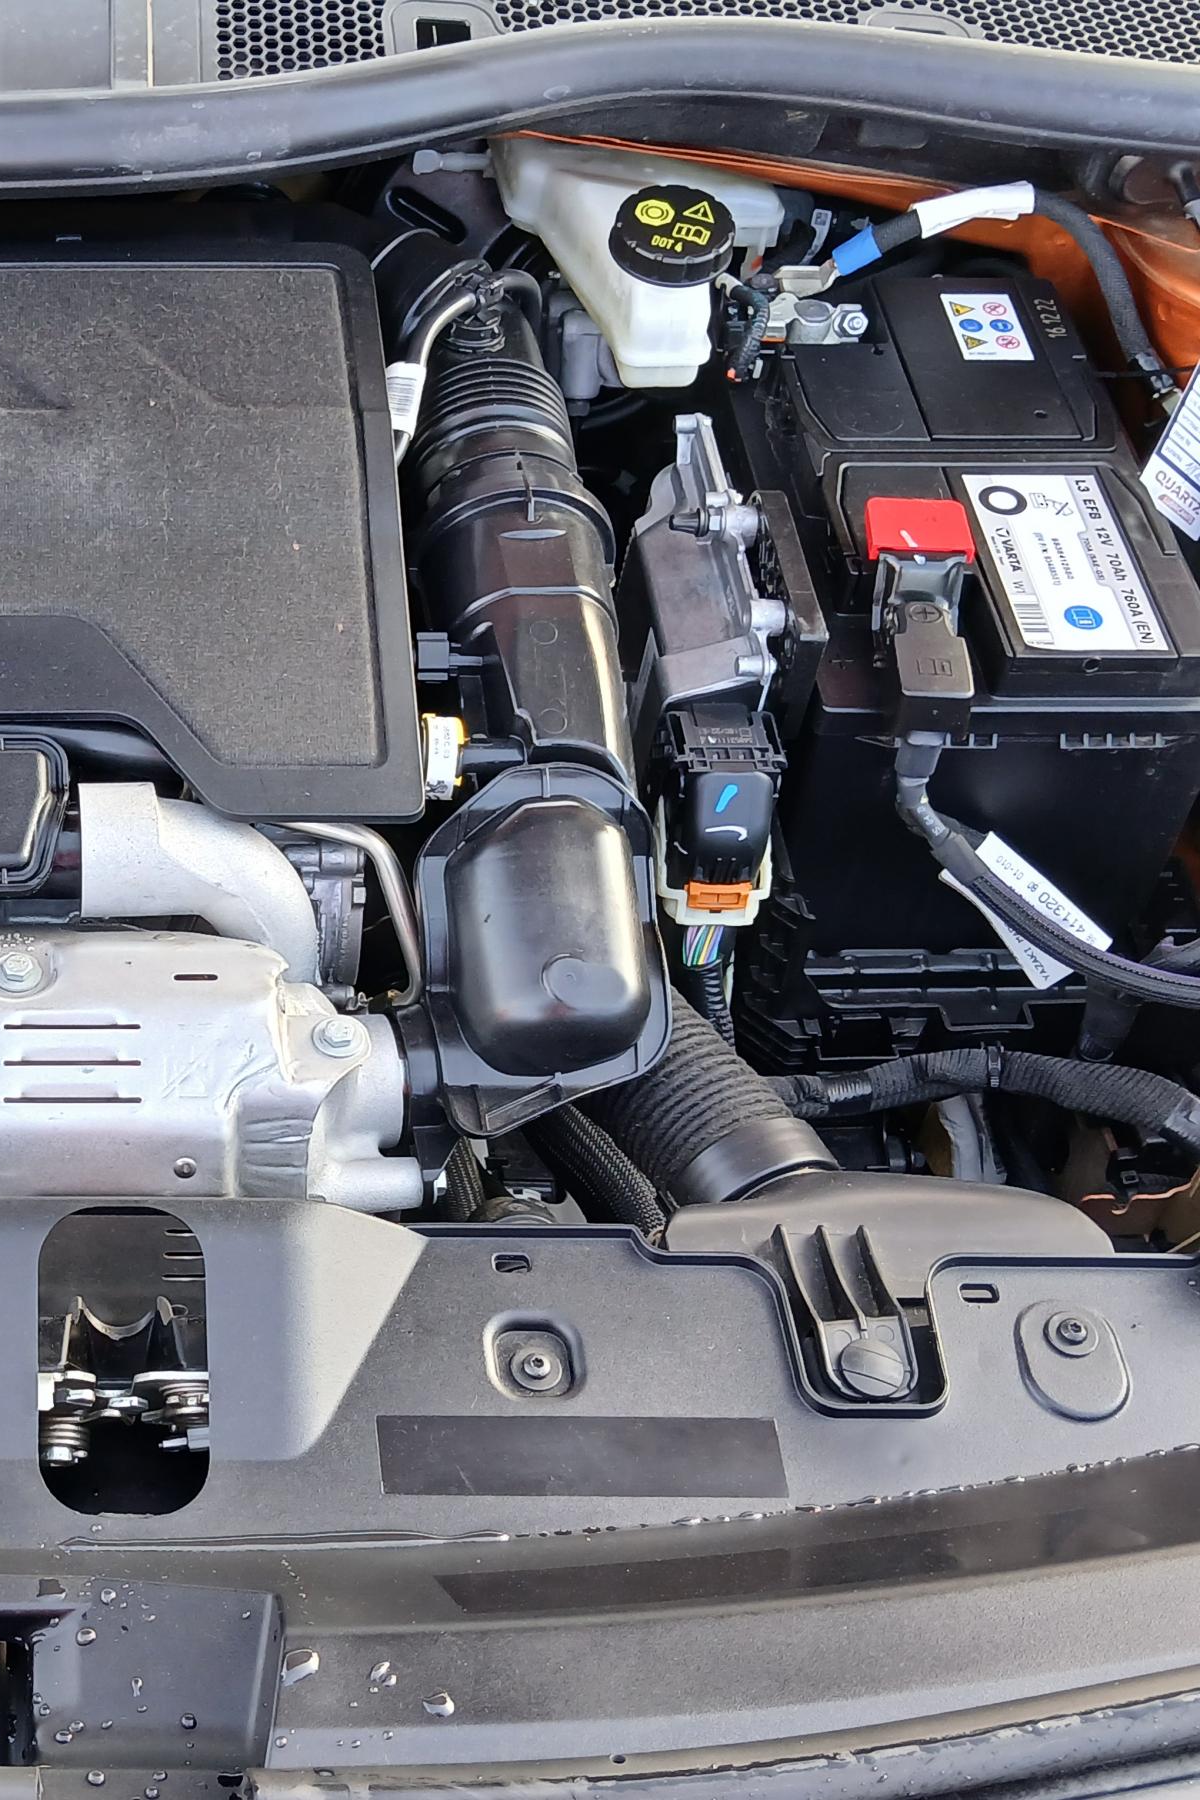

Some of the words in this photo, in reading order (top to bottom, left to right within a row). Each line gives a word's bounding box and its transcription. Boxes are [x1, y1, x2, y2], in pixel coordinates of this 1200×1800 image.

[651, 234, 675, 250] DOT
[674, 241, 683, 253] 4
[1075, 479, 1090, 493] L3
[1083, 498, 1102, 520] EFB
[1095, 526, 1114, 547] 12V
[1000, 538, 1022, 573] VARTA
[1106, 553, 1127, 582] 70Ah
[1121, 588, 1144, 618] 760A
[1131, 620, 1155, 644] (EN)
[1038, 891, 1085, 933] 411320
[1024, 946, 1050, 982] YAZAKI
